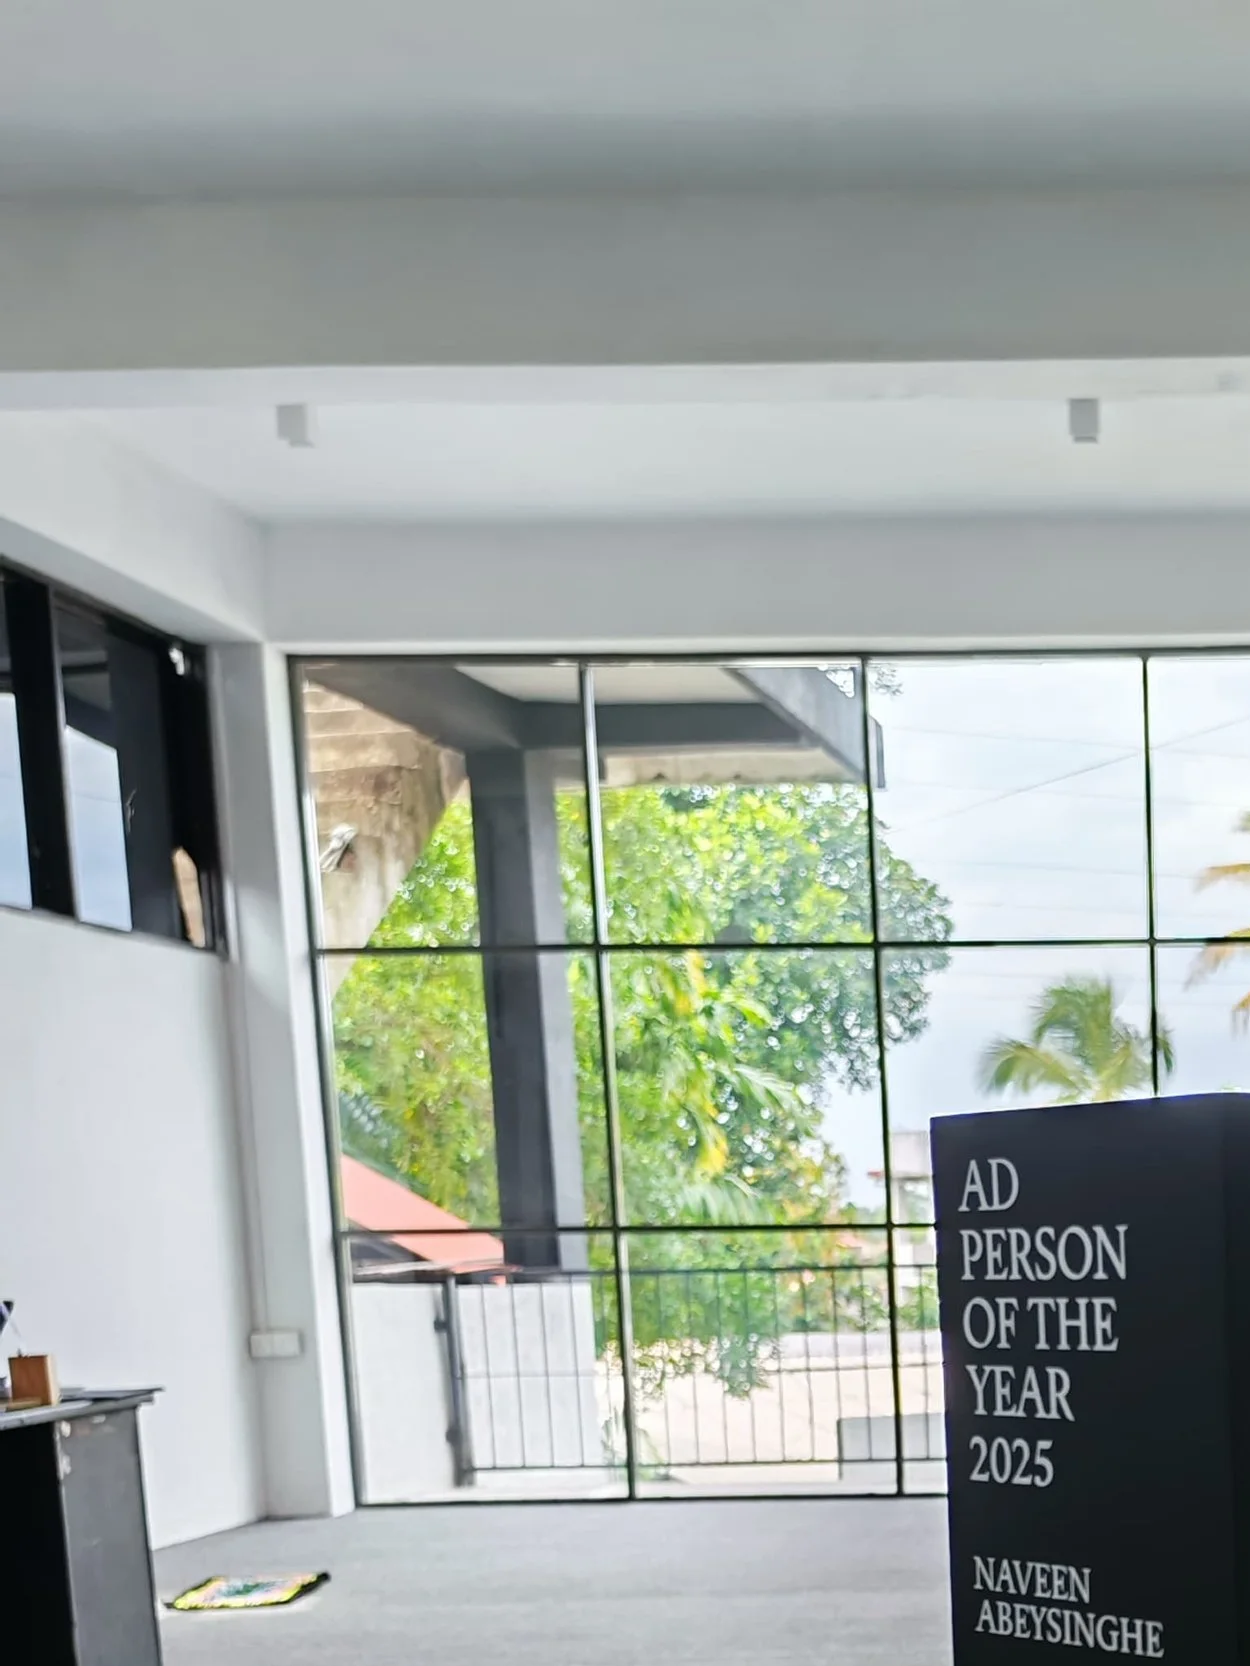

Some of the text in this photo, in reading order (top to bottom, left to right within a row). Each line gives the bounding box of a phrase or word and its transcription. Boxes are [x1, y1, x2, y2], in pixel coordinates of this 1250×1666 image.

[957, 1157, 1020, 1212] AD
[959, 1224, 1129, 1281] PERSON
[963, 1297, 1119, 1352] OF THE
[965, 1364, 1075, 1422] YEAR
[969, 1435, 1054, 1488] 2025
[973, 1555, 1092, 1604] NAVEEN
[975, 1599, 1165, 1659] ABEYSINGHE
